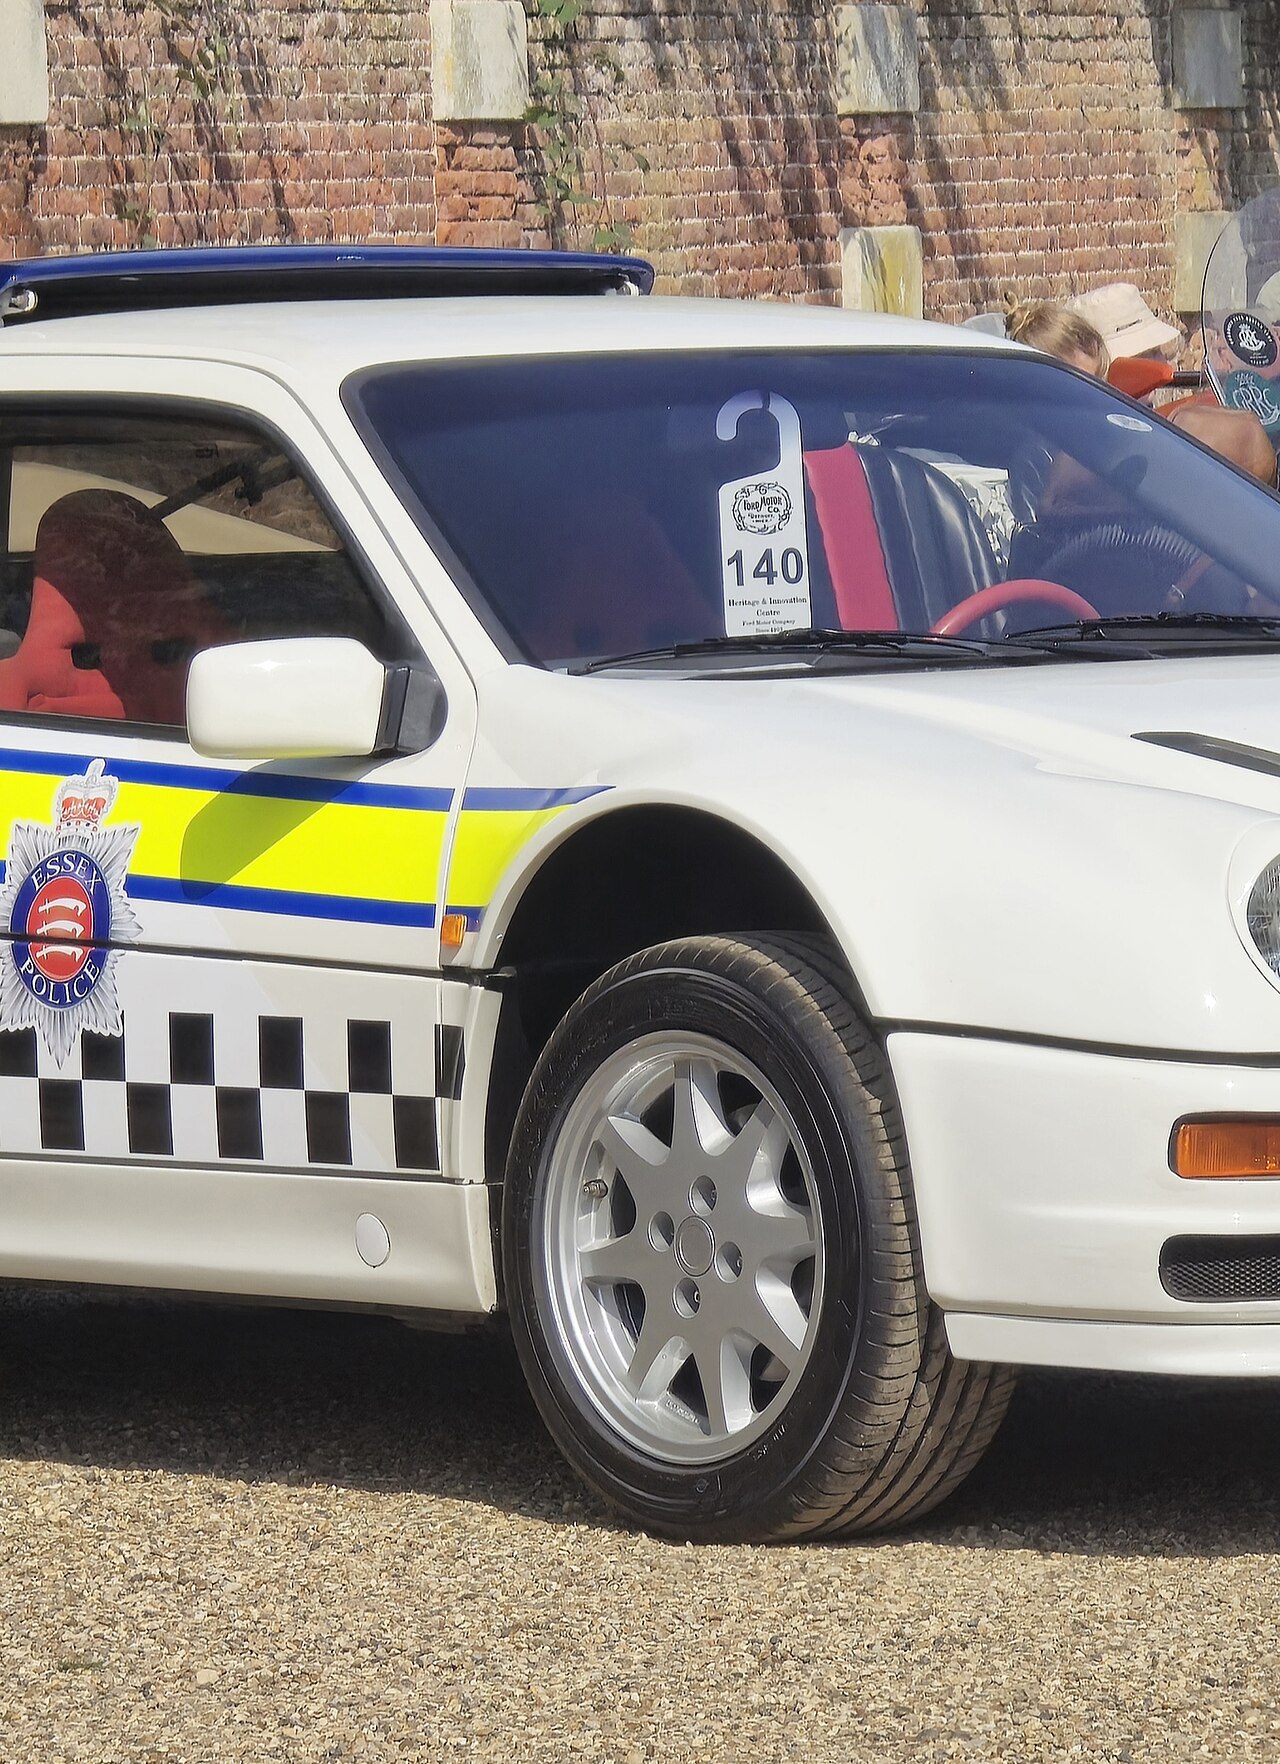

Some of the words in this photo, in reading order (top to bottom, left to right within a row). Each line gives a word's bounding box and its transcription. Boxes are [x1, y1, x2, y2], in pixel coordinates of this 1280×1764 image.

[727, 548, 804, 587] 140
[728, 599, 760, 607] Heritage
[769, 596, 808, 605] Innovation
[30, 853, 104, 896] ESSEX
[19, 960, 101, 1004] POLICE
